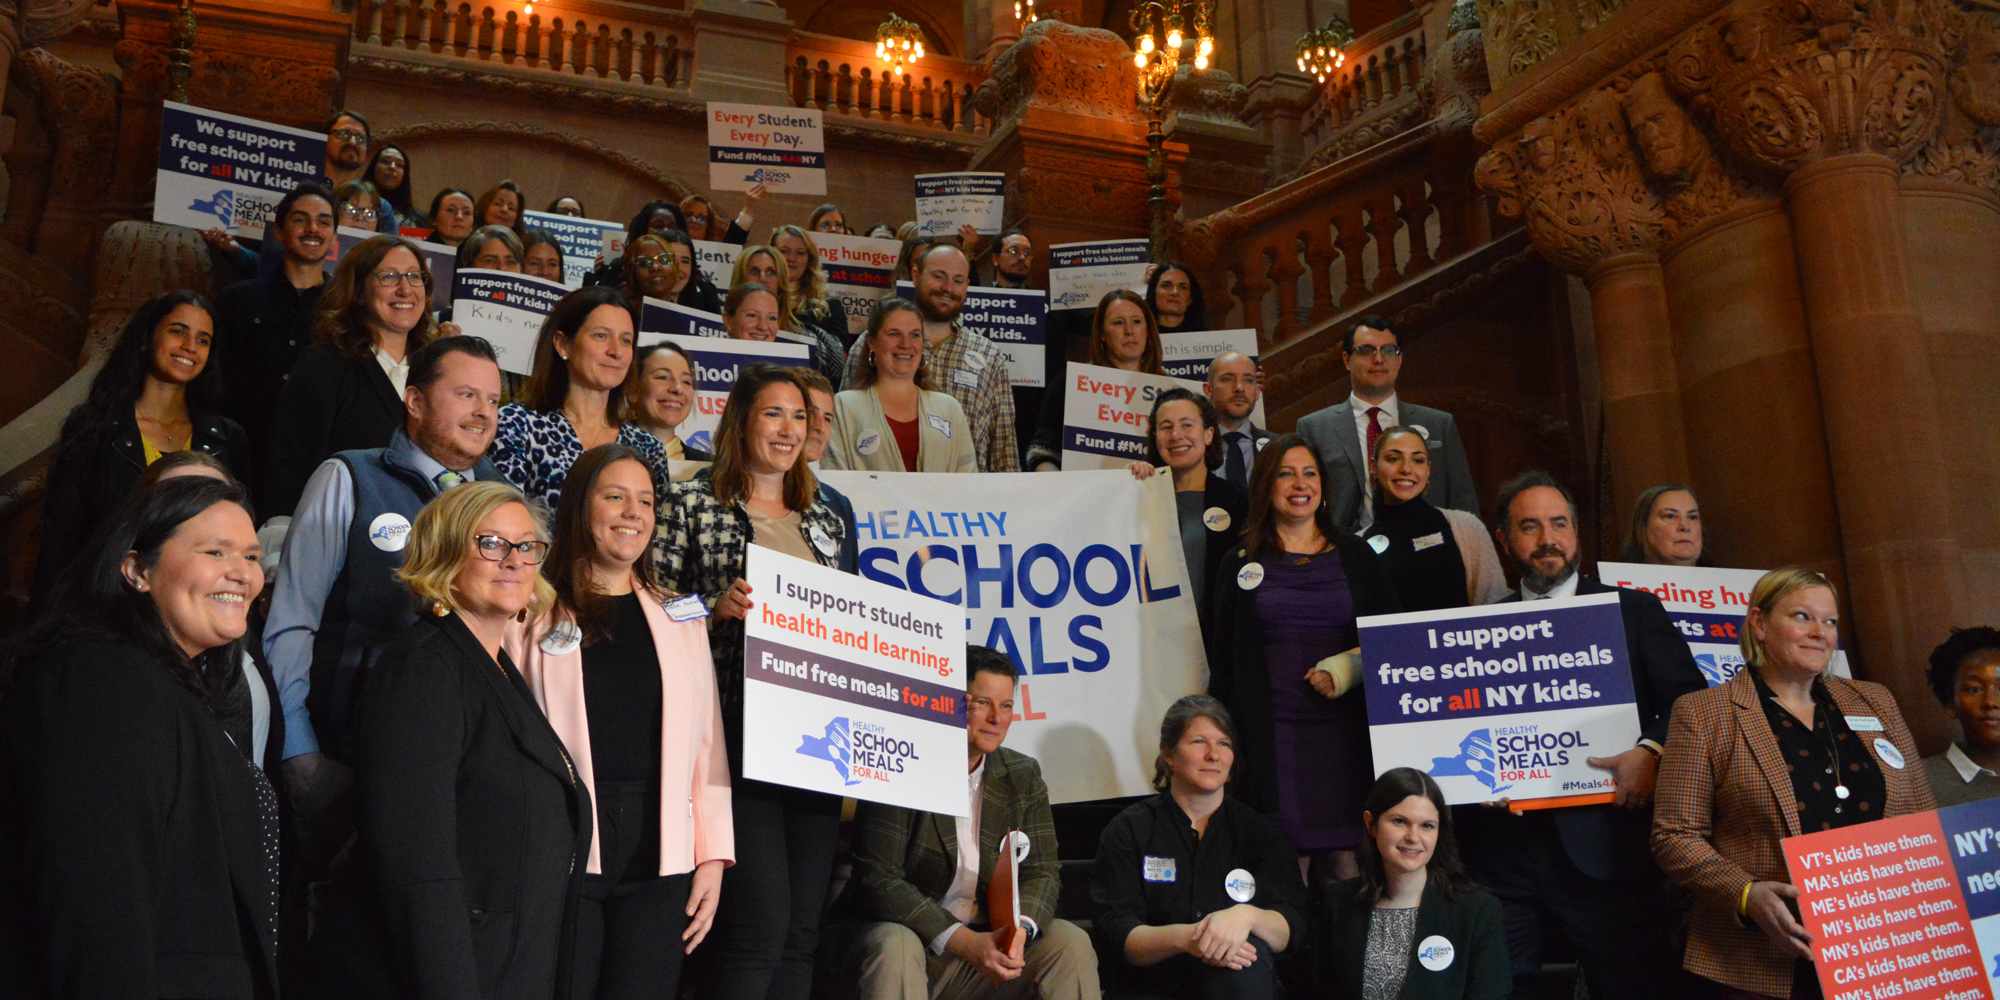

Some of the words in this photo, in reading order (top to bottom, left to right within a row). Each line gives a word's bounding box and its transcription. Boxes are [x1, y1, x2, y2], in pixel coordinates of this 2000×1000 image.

[715, 111, 754, 128] Every
[758, 114, 816, 128] Student.
[196, 119, 224, 136] We
[227, 129, 296, 152] support
[731, 130, 769, 146] Every
[774, 132, 803, 148] Day.
[170, 134, 207, 153] free
[210, 142, 264, 165] school
[268, 157, 316, 174] meals
[718, 151, 743, 159] Fund
[180, 156, 207, 173] for
[211, 164, 231, 178] all
[235, 167, 261, 183] NY
[235, 198, 278, 214] SCHOO
[234, 209, 268, 222] MEAL
[234, 219, 249, 227] FOR
[251, 221, 264, 229] ALL
[543, 221, 598, 235] support
[577, 237, 603, 247] mea
[842, 247, 896, 265] hunger
[1057, 250, 1084, 258] support
[468, 278, 512, 290] support
[514, 283, 535, 294] free
[832, 270, 847, 280] at
[850, 272, 891, 284] schoo
[473, 288, 491, 297] for
[492, 292, 505, 300] all
[507, 294, 523, 304] NY
[524, 298, 546, 310] kids
[964, 298, 1016, 308] upport
[472, 304, 512, 323] Kids
[846, 307, 872, 317] EALS
[991, 314, 1036, 325] meals
[689, 320, 696, 334] I
[989, 328, 1026, 340] kids.
[1181, 344, 1189, 353] is
[1191, 341, 1236, 354] simple:
[1077, 375, 1136, 405] Every
[1075, 434, 1114, 450] Fund
[853, 510, 1007, 539] HEALTHY
[858, 543, 1181, 609] SCHOOL
[776, 574, 781, 594] I
[787, 582, 866, 618] support
[871, 606, 943, 639] student
[1428, 629, 1437, 649] I
[1443, 620, 1553, 650] support
[1710, 622, 1738, 638] at
[762, 603, 827, 640] health
[832, 628, 868, 651] and
[874, 634, 954, 677] learning.
[1378, 663, 1435, 684] free
[1440, 652, 1527, 680] school
[1532, 644, 1613, 671] meals
[761, 651, 807, 679] Fund
[811, 664, 847, 689] free
[851, 675, 899, 701] meals
[901, 686, 928, 708] for
[930, 695, 954, 714] all!
[1399, 693, 1442, 714] for
[1448, 688, 1481, 710] all
[1485, 684, 1528, 708] NY
[1533, 679, 1601, 703] kids.
[853, 720, 885, 734] HEALTHY
[1494, 725, 1538, 736] HEALTHY
[853, 730, 919, 760] SCHOOL
[1496, 731, 1589, 754] SCHOOL
[853, 749, 904, 774] MEALS
[1499, 750, 1569, 770] MEALS
[853, 766, 871, 779] FOR
[874, 769, 890, 783] ALL
[1500, 770, 1526, 781] FOR
[1528, 768, 1551, 779] ALL
[1562, 778, 1617, 791] #Meals4A
[1800, 851, 1833, 870] VT's
[1834, 845, 1862, 863] kids
[1864, 840, 1897, 858] have
[1898, 833, 1937, 852] them.
[1804, 874, 1839, 893] MA's
[1840, 868, 1870, 886] kids
[1872, 862, 1904, 880] have
[1905, 855, 1944, 873] them.
[1811, 897, 1845, 916] ME's
[1847, 890, 1876, 909] kids
[1877, 884, 1911, 902] have
[1912, 876, 1950, 894] them.
[1822, 919, 1852, 938] MI's
[1853, 912, 1883, 931] kids
[1884, 906, 1917, 925] have
[1918, 899, 1958, 917] them.
[1822, 942, 1859, 962] MN's
[1859, 935, 1889, 954] kids
[1891, 929, 1923, 948] have
[1925, 920, 1964, 938] them.
[1834, 965, 1865, 984] CA's
[1866, 958, 1896, 977] kids
[1898, 951, 1930, 970] have
[1931, 942, 1971, 961] them.
[1873, 981, 1903, 999] kids
[1904, 974, 1937, 992] have
[1938, 965, 1978, 983] them.
